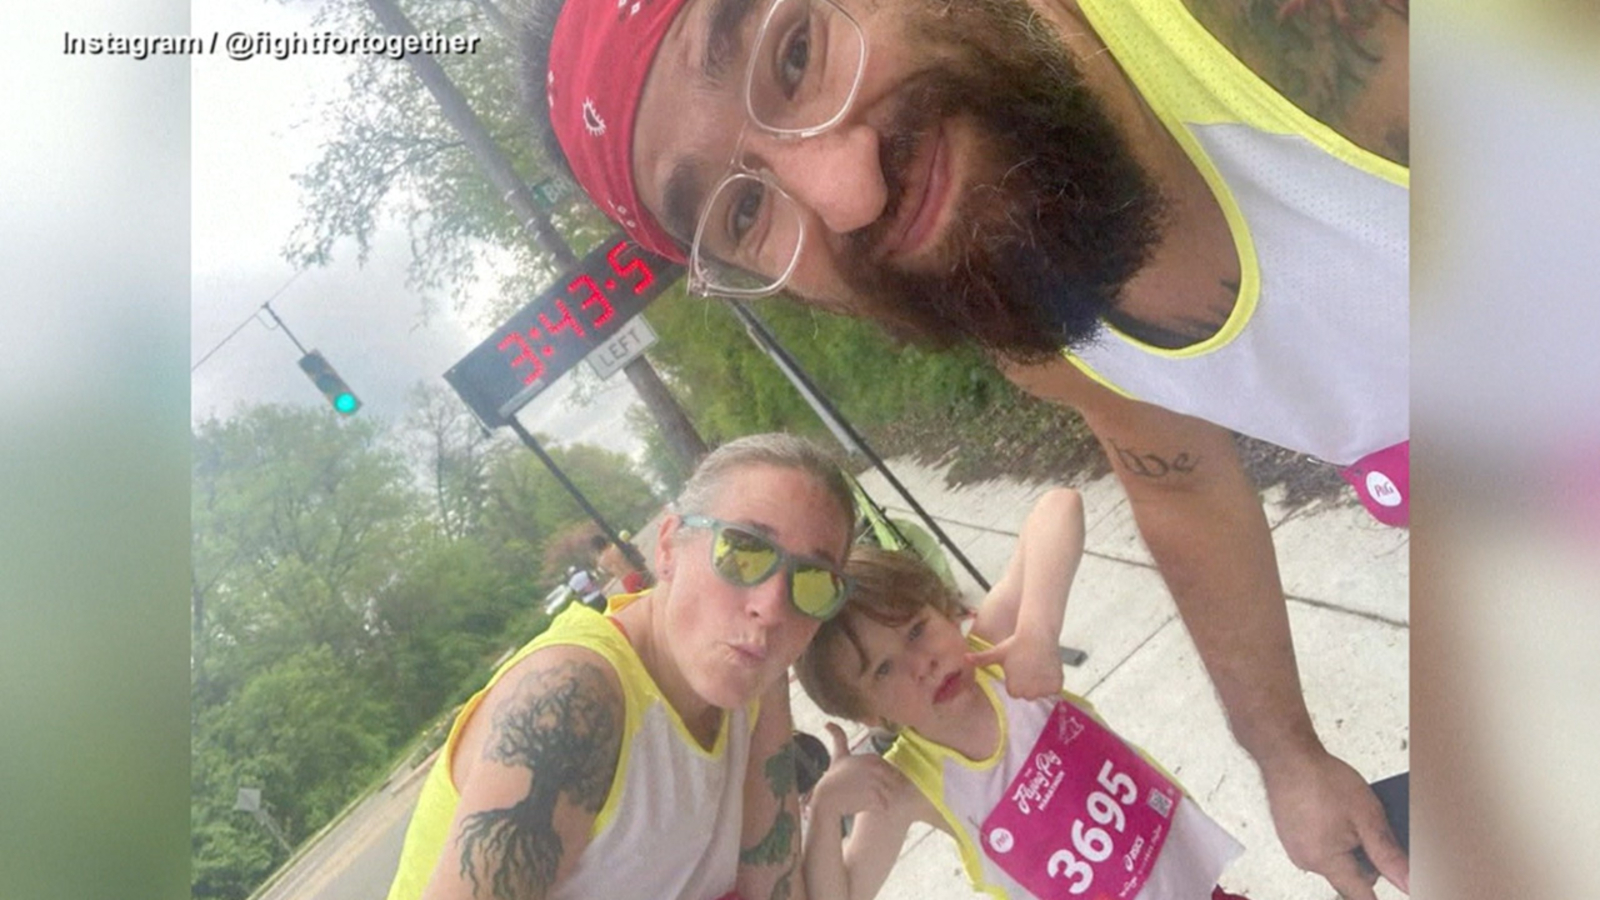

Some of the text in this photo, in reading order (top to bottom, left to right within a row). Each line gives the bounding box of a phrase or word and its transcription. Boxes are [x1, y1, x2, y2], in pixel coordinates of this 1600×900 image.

[598, 328, 641, 368] LEFT
[1012, 749, 1062, 815] Flying Pig
[1038, 770, 1065, 812] MARATHON
[1047, 759, 1138, 895] 3695
